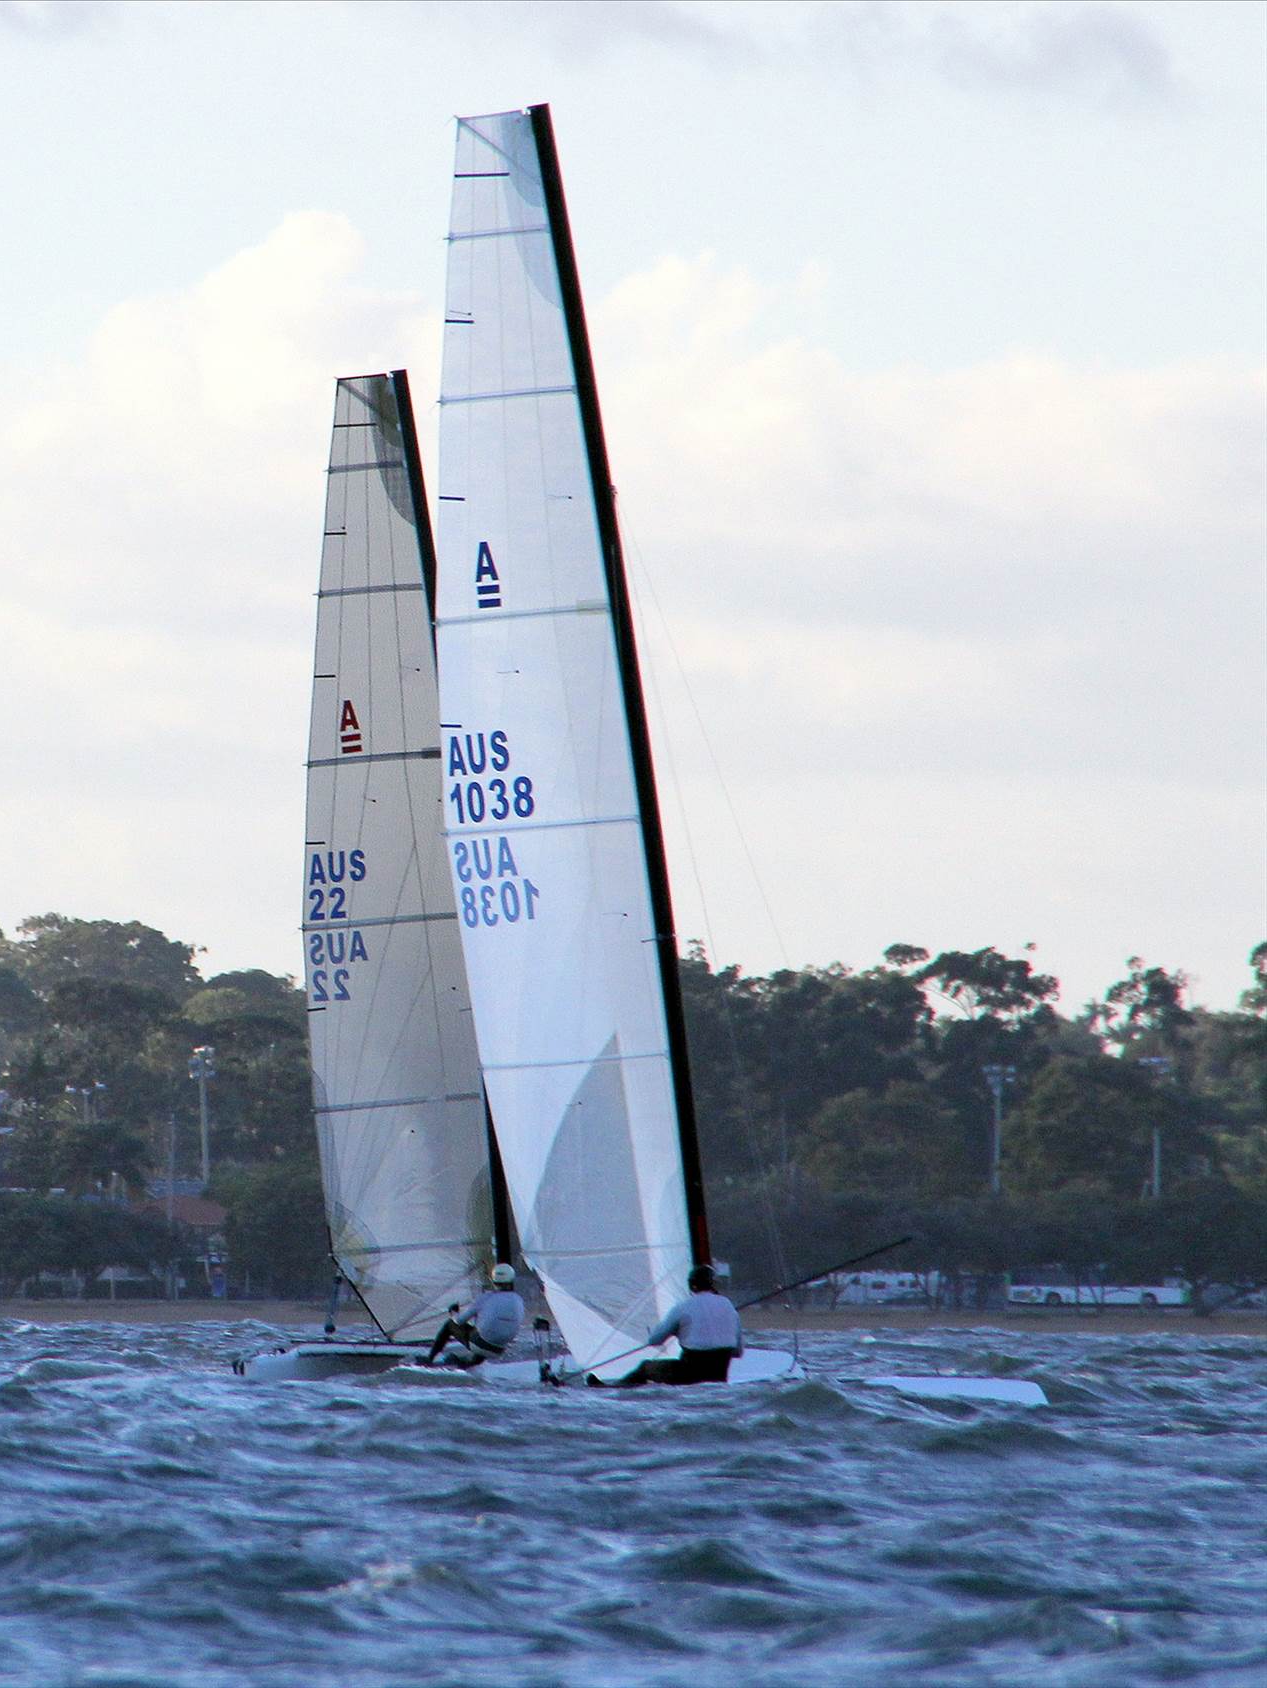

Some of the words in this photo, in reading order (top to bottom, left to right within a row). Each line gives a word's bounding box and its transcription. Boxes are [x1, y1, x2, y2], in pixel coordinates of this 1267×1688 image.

[475, 541, 499, 582] A
[340, 699, 359, 732] A
[448, 730, 510, 777] AUS
[449, 776, 535, 824] 1038
[309, 849, 366, 886] AUS
[309, 887, 347, 921] 22
